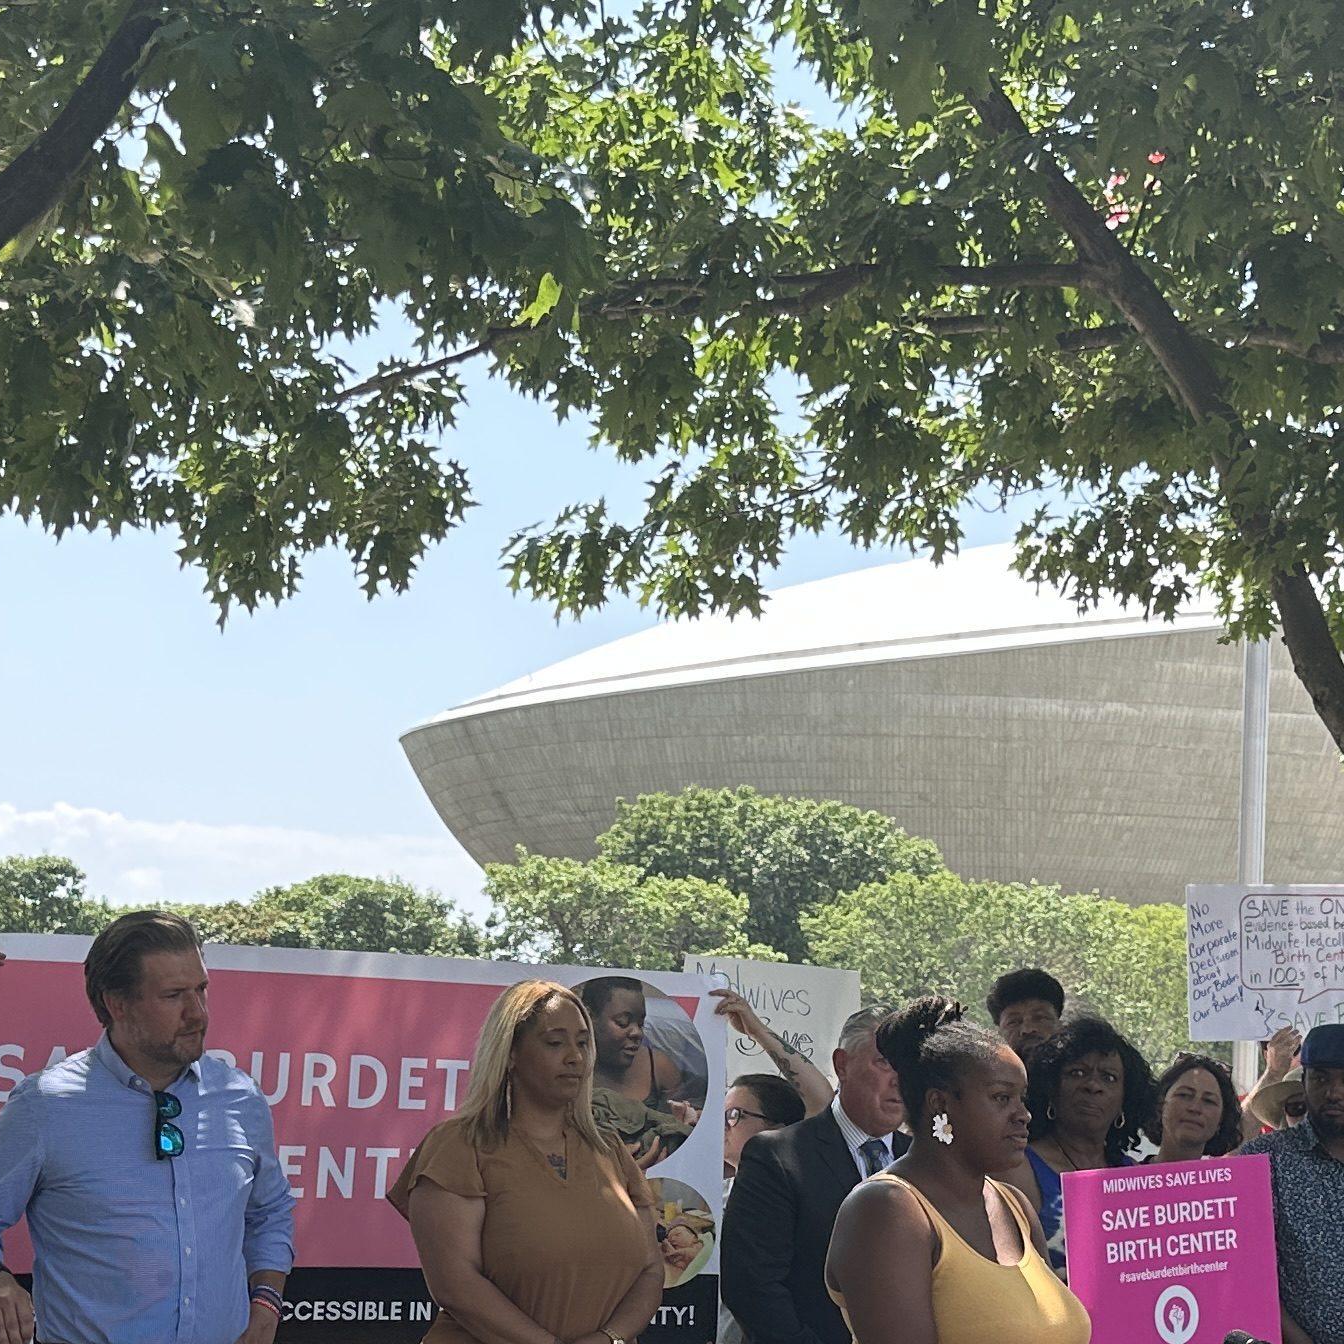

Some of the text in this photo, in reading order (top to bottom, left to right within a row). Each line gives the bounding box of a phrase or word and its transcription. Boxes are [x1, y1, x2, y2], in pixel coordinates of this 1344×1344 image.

[1191, 902, 1209, 919] No
[1244, 899, 1289, 918] SAVE
[1296, 901, 1315, 915] the
[1191, 919, 1223, 939] More
[1189, 931, 1237, 959] Corporate
[1272, 949, 1311, 965] Birth
[1250, 971, 1262, 984] in
[1314, 965, 1328, 986] of
[1193, 985, 1212, 1000] Our
[1193, 1008, 1210, 1022] Our
[1103, 1168, 1232, 1194] MIDWIVES SAVE LIVES
[1101, 1197, 1238, 1232] SAVE BURDETT
[1106, 1229, 1238, 1264] BIRTH CENTER
[1119, 1260, 1229, 1284] #saveburdettbirthcenter
[281, 1300, 432, 1322] CCESSIBLE IN
